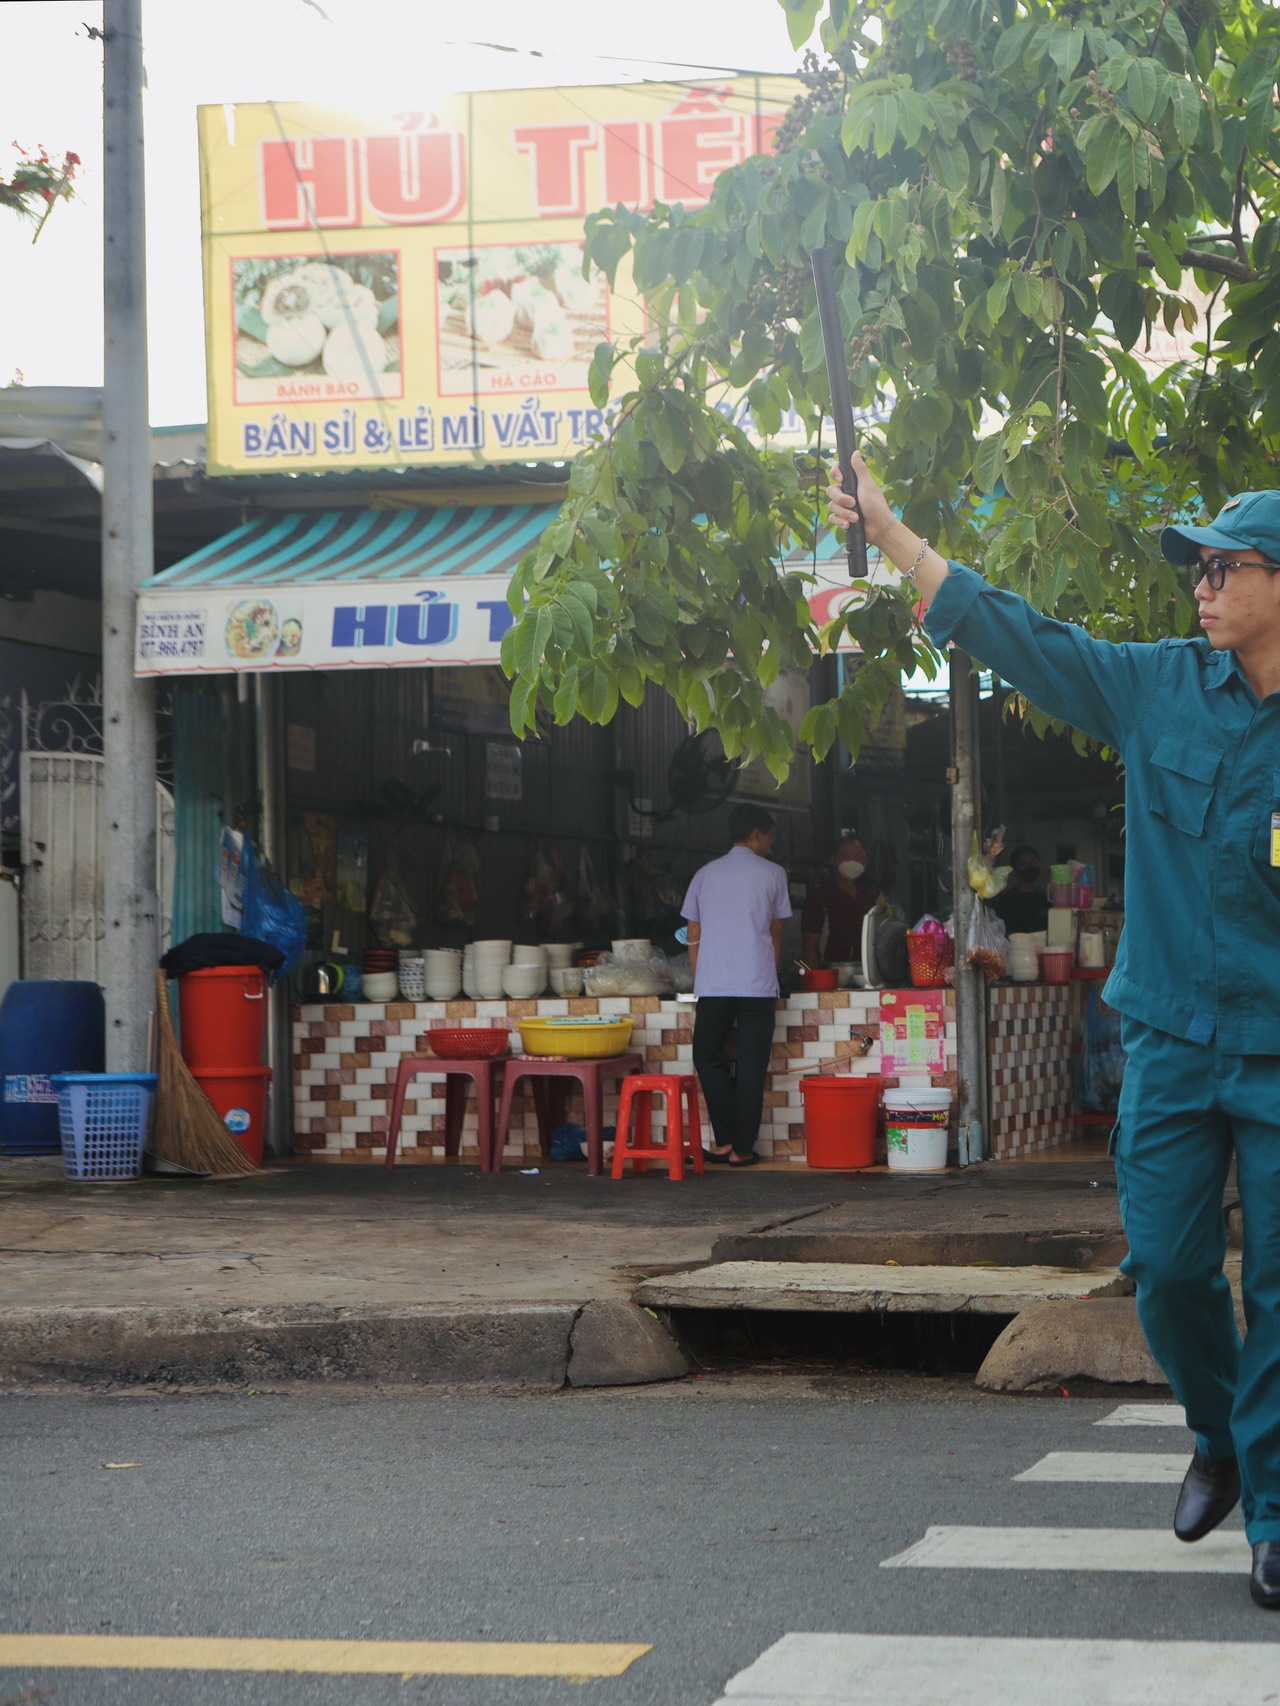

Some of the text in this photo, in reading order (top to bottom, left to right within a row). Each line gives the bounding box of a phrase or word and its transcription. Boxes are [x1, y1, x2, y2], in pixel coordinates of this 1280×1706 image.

[258, 84, 788, 232] HỦ TIẾ
[277, 380, 360, 398] BÁNH BAO
[243, 410, 316, 457] BÁN
[322, 405, 356, 455] SỈ
[363, 418, 390, 454] &
[399, 404, 435, 453] LẺ
[442, 404, 484, 451] MÌ
[492, 394, 562, 448] VẮT
[331, 590, 459, 651] HỦ
